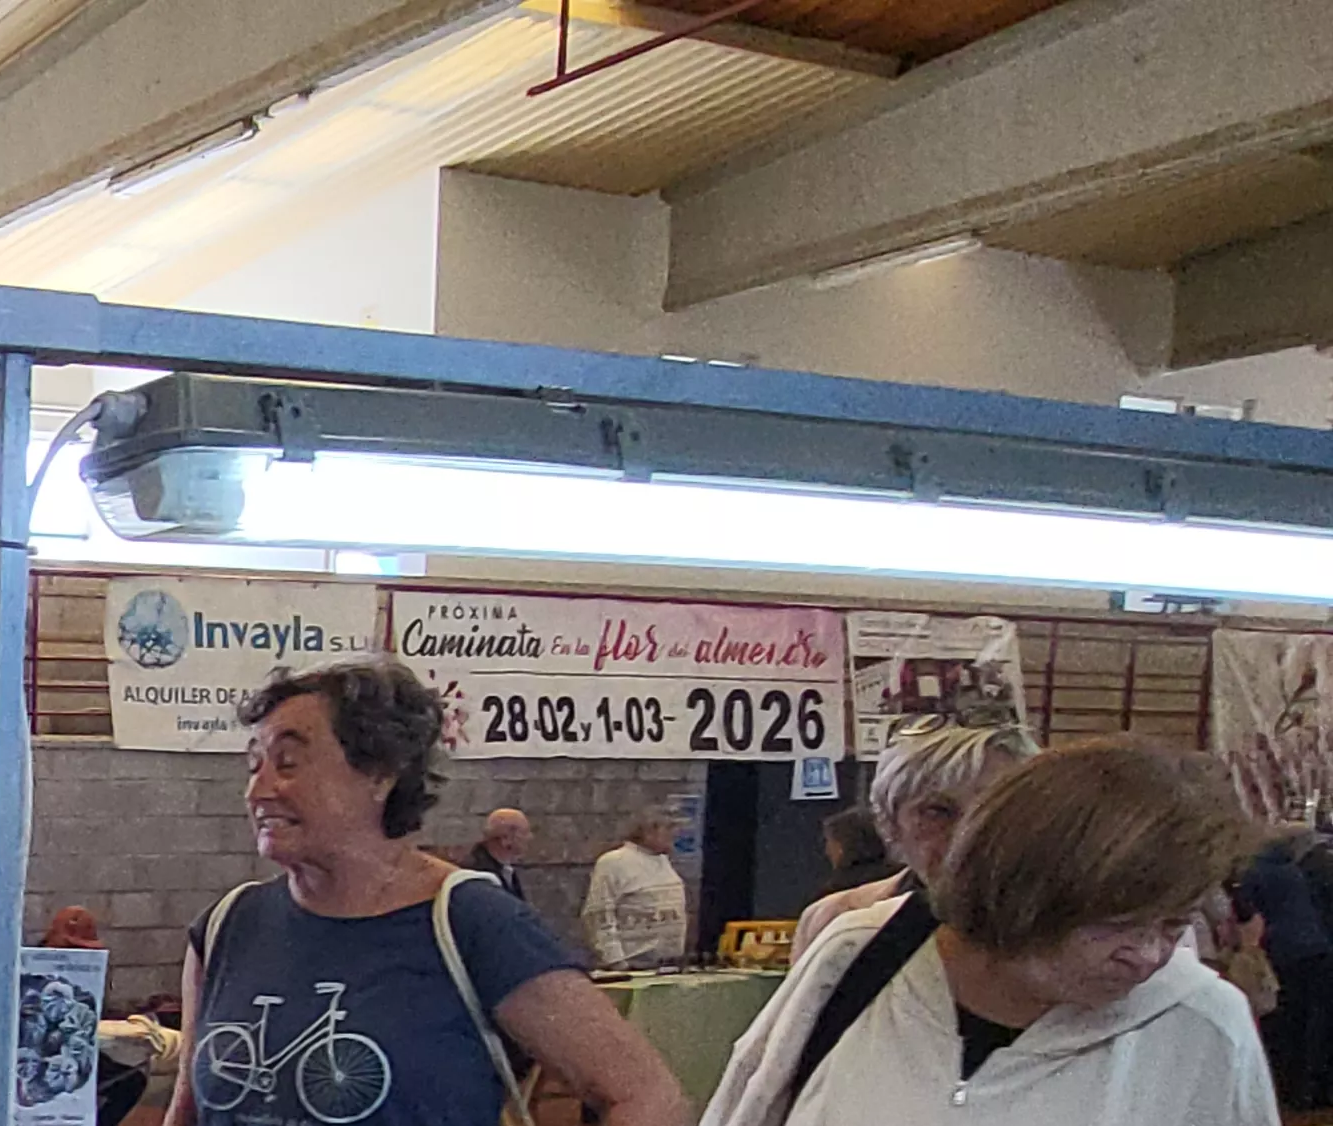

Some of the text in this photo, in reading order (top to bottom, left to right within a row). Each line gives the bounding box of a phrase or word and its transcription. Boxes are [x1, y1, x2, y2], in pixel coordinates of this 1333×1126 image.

[193, 611, 324, 660] Invayla
[402, 618, 543, 659] Caminata
[593, 618, 659, 671] flor
[123, 685, 212, 705] ALQUILER
[216, 687, 237, 704] DE
[686, 687, 825, 752] 2026
